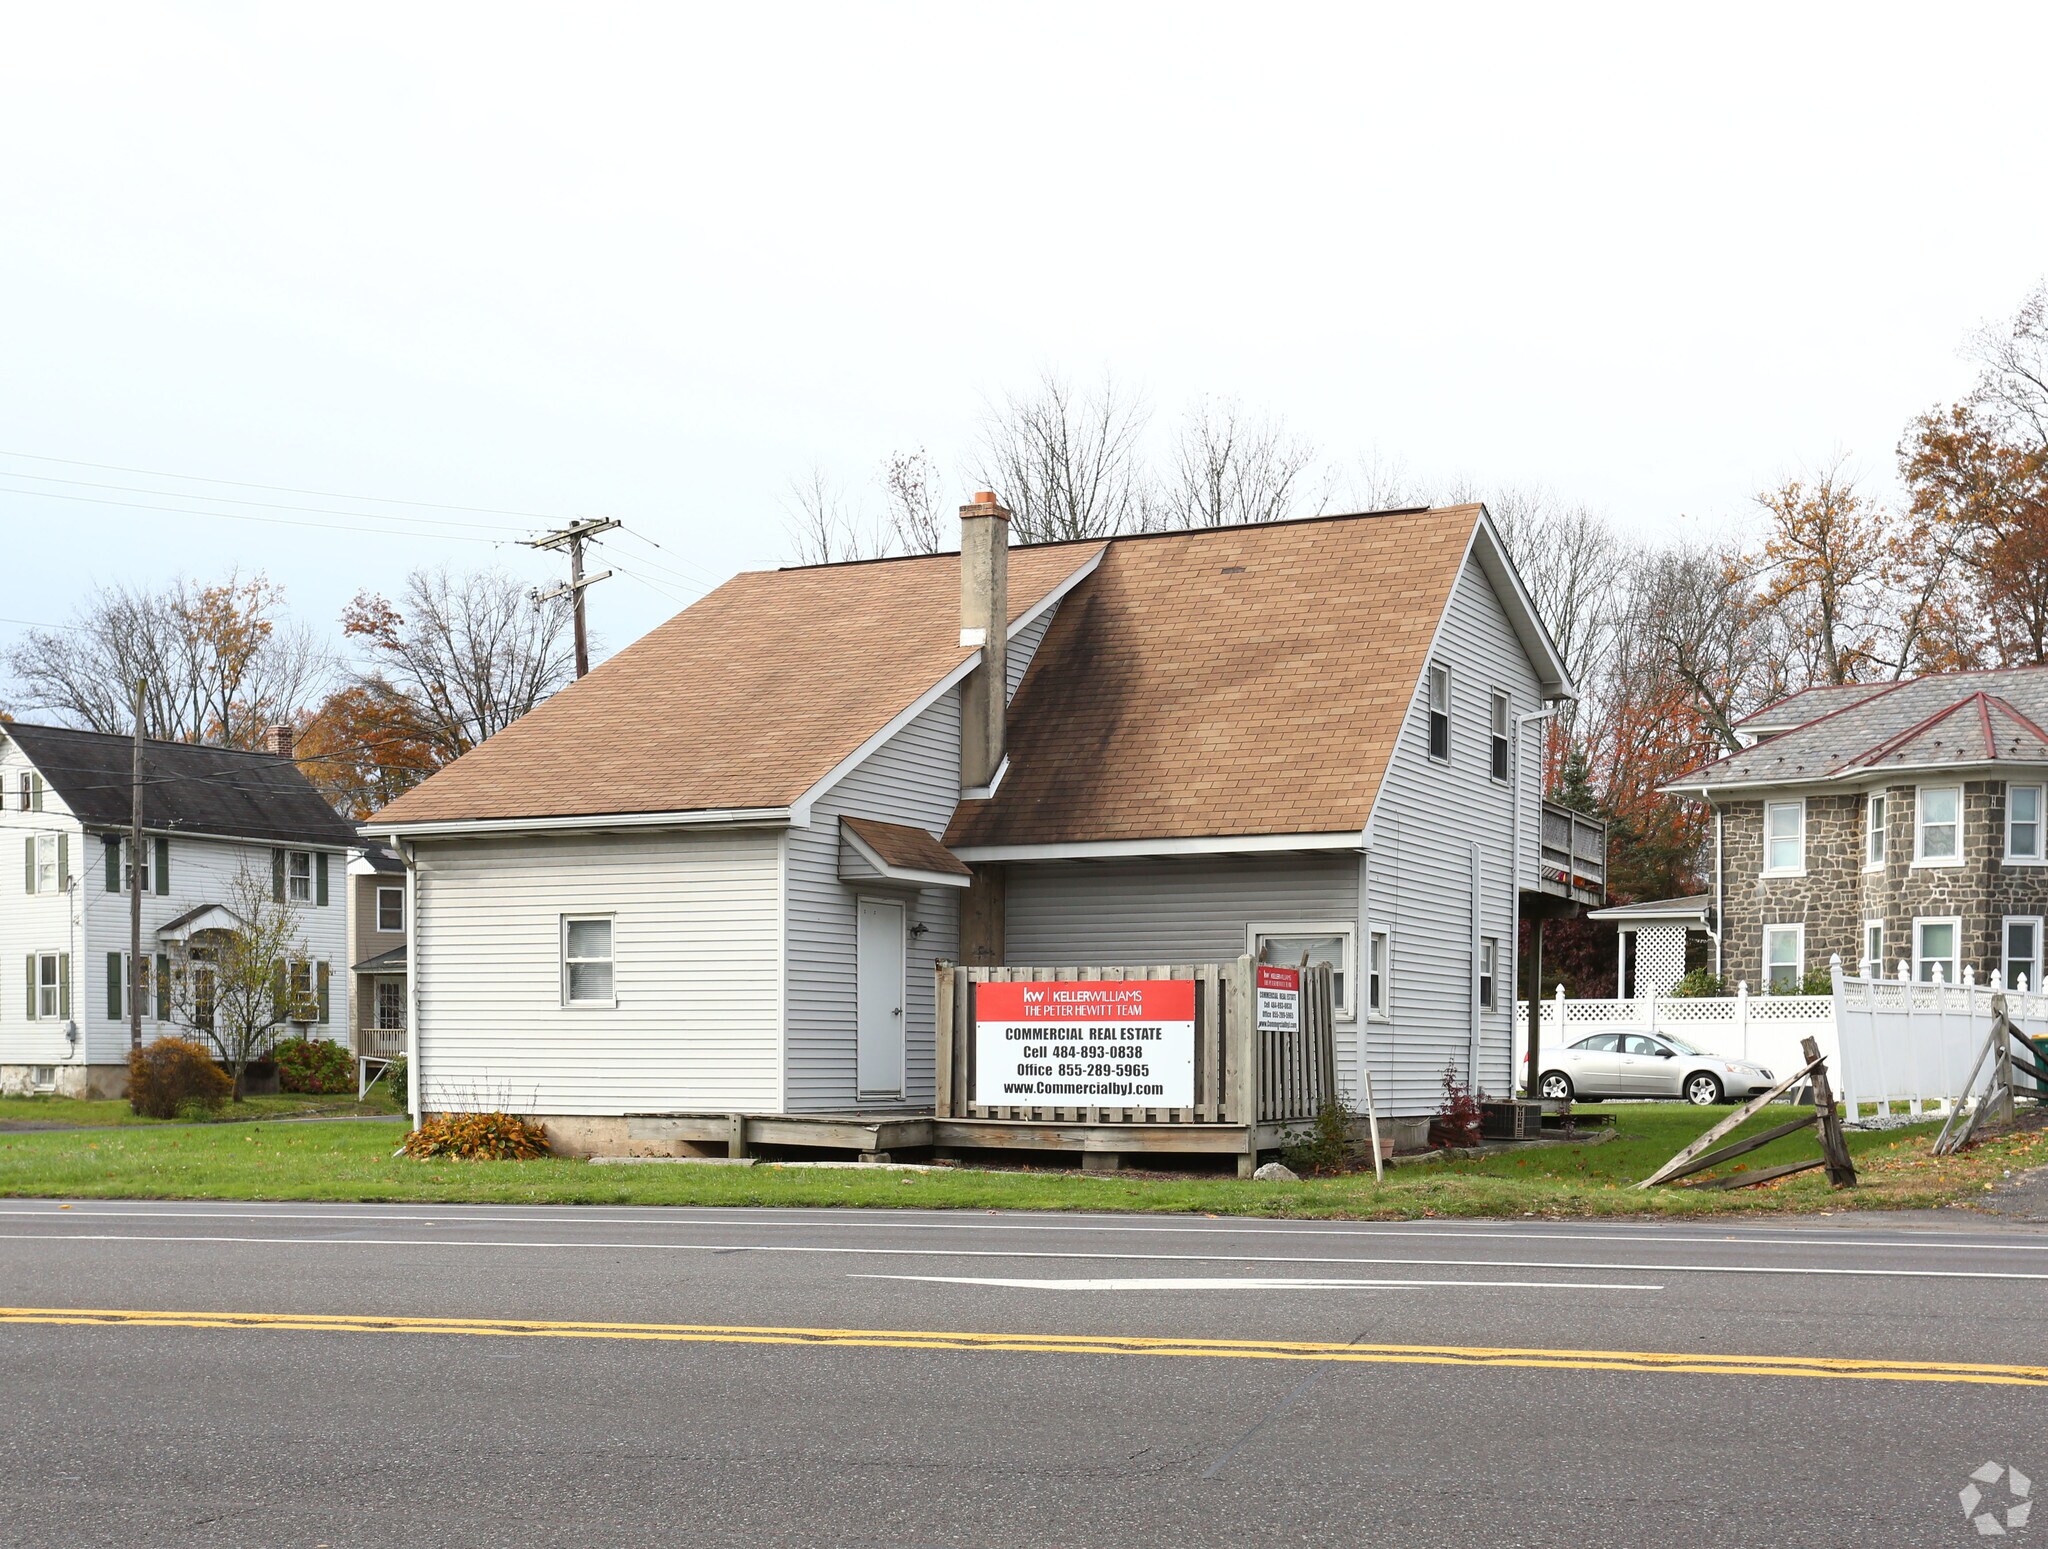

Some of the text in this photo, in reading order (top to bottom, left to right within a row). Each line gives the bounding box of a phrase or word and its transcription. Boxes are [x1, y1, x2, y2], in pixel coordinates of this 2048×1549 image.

[1023, 987, 1142, 1003] kw KELLERWILLIAMS
[1024, 1005, 1142, 1016] THE PETER HEWITT TEAM
[1005, 1027, 1162, 1040] COMMERCIAL REAL ESTATE
[1023, 1046, 1143, 1059] Cell 484-893-0838
[1017, 1063, 1149, 1077] Office 855-289-5965
[1003, 1081, 1164, 1096] www.CommercialbyJ.com
